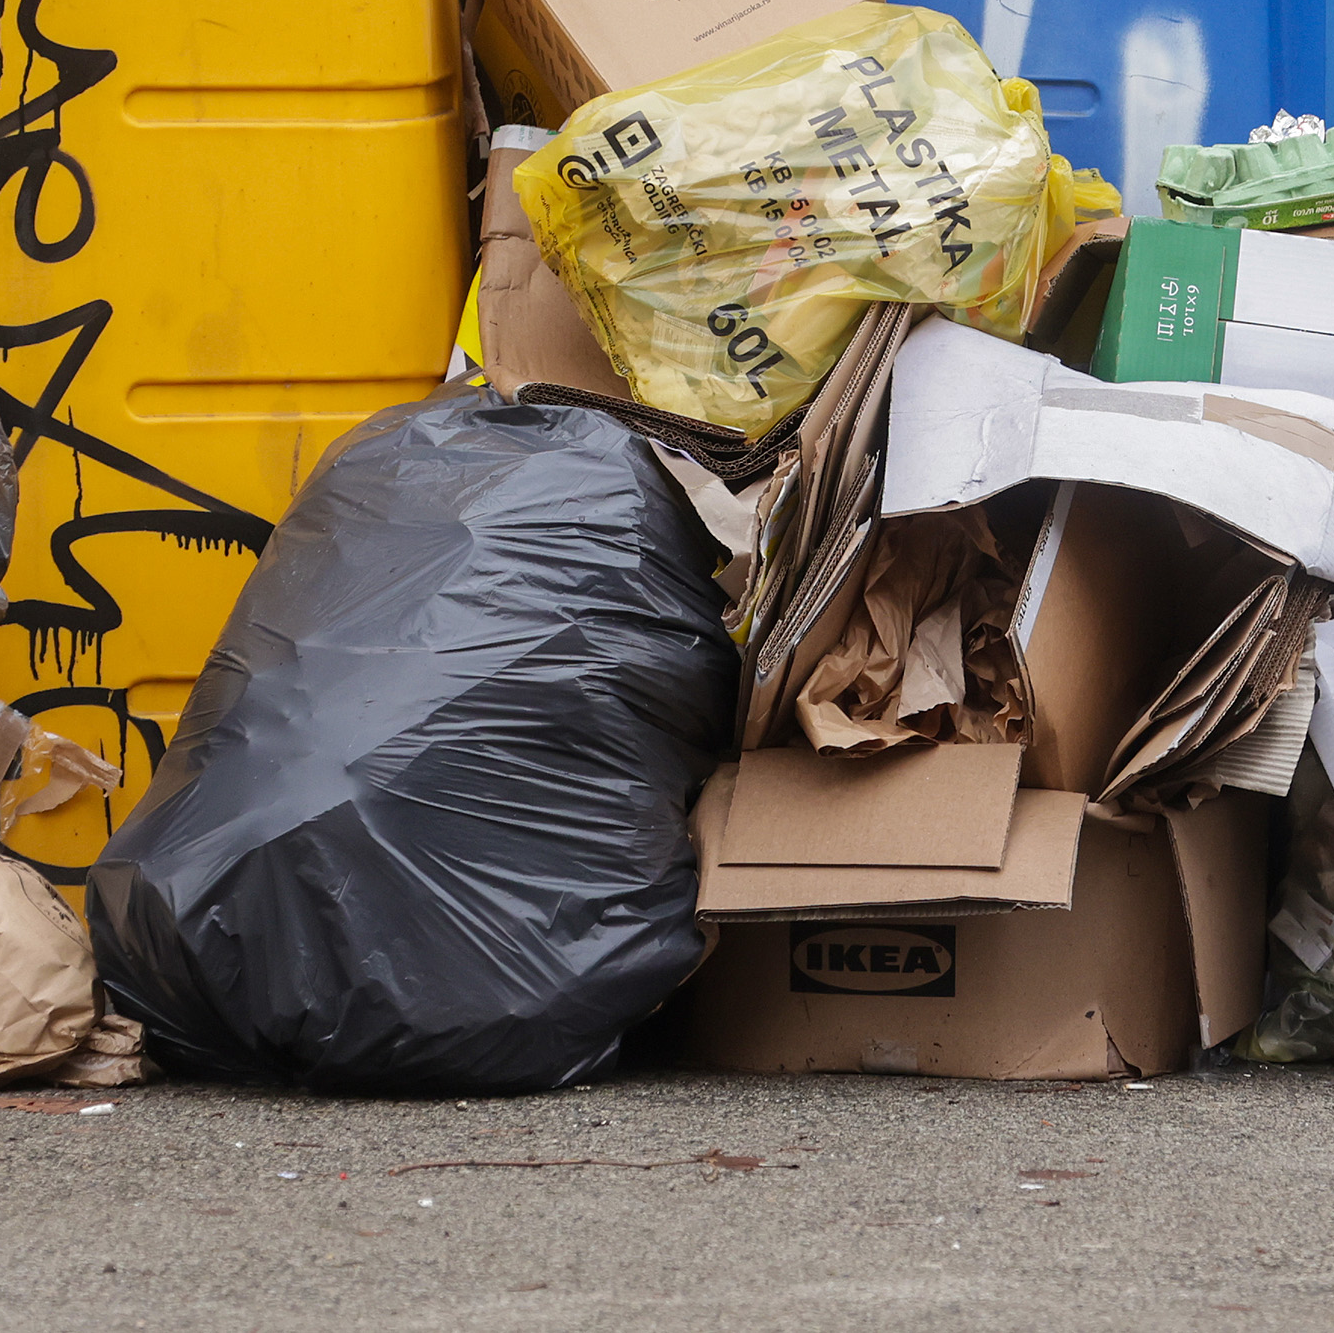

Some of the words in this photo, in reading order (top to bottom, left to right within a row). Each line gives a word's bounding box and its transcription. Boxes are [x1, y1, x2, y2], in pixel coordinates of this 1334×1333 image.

[638, 173, 680, 235] HOLDING
[651, 165, 708, 256] ZAGREBAČKI
[739, 161, 768, 194] KB
[761, 198, 785, 222] 15
[764, 151, 792, 184] KB
[786, 188, 810, 211] 15
[799, 214, 824, 237] 01
[814, 237, 836, 258] 02
[807, 107, 913, 258] METAL
[841, 56, 975, 276] PLASTIKA
[707, 302, 786, 399] 60L
[806, 943, 942, 975] IKEA
